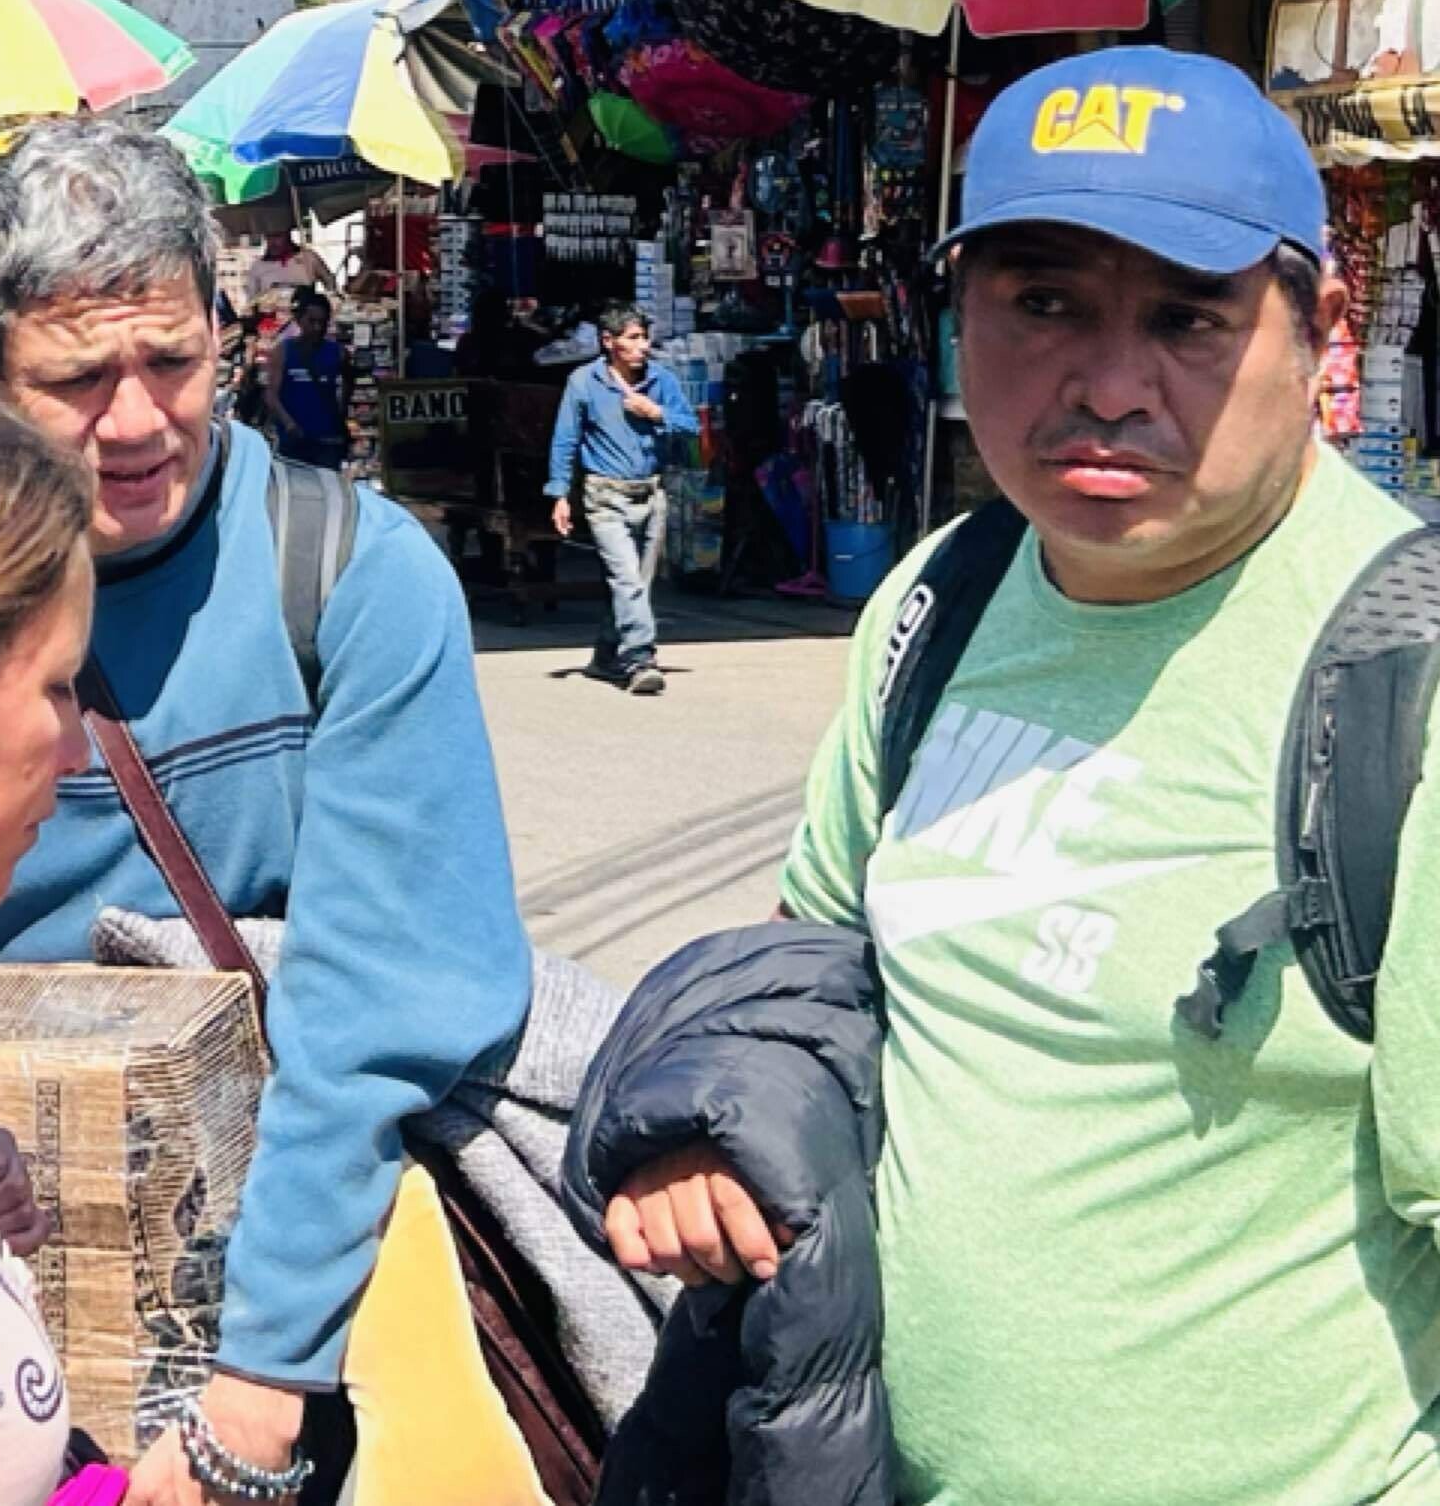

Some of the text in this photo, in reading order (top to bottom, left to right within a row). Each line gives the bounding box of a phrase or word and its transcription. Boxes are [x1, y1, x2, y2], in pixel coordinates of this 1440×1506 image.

[1031, 83, 1166, 155] CAT
[888, 701, 1145, 874] NIKE
[1021, 904, 1119, 994] SB
